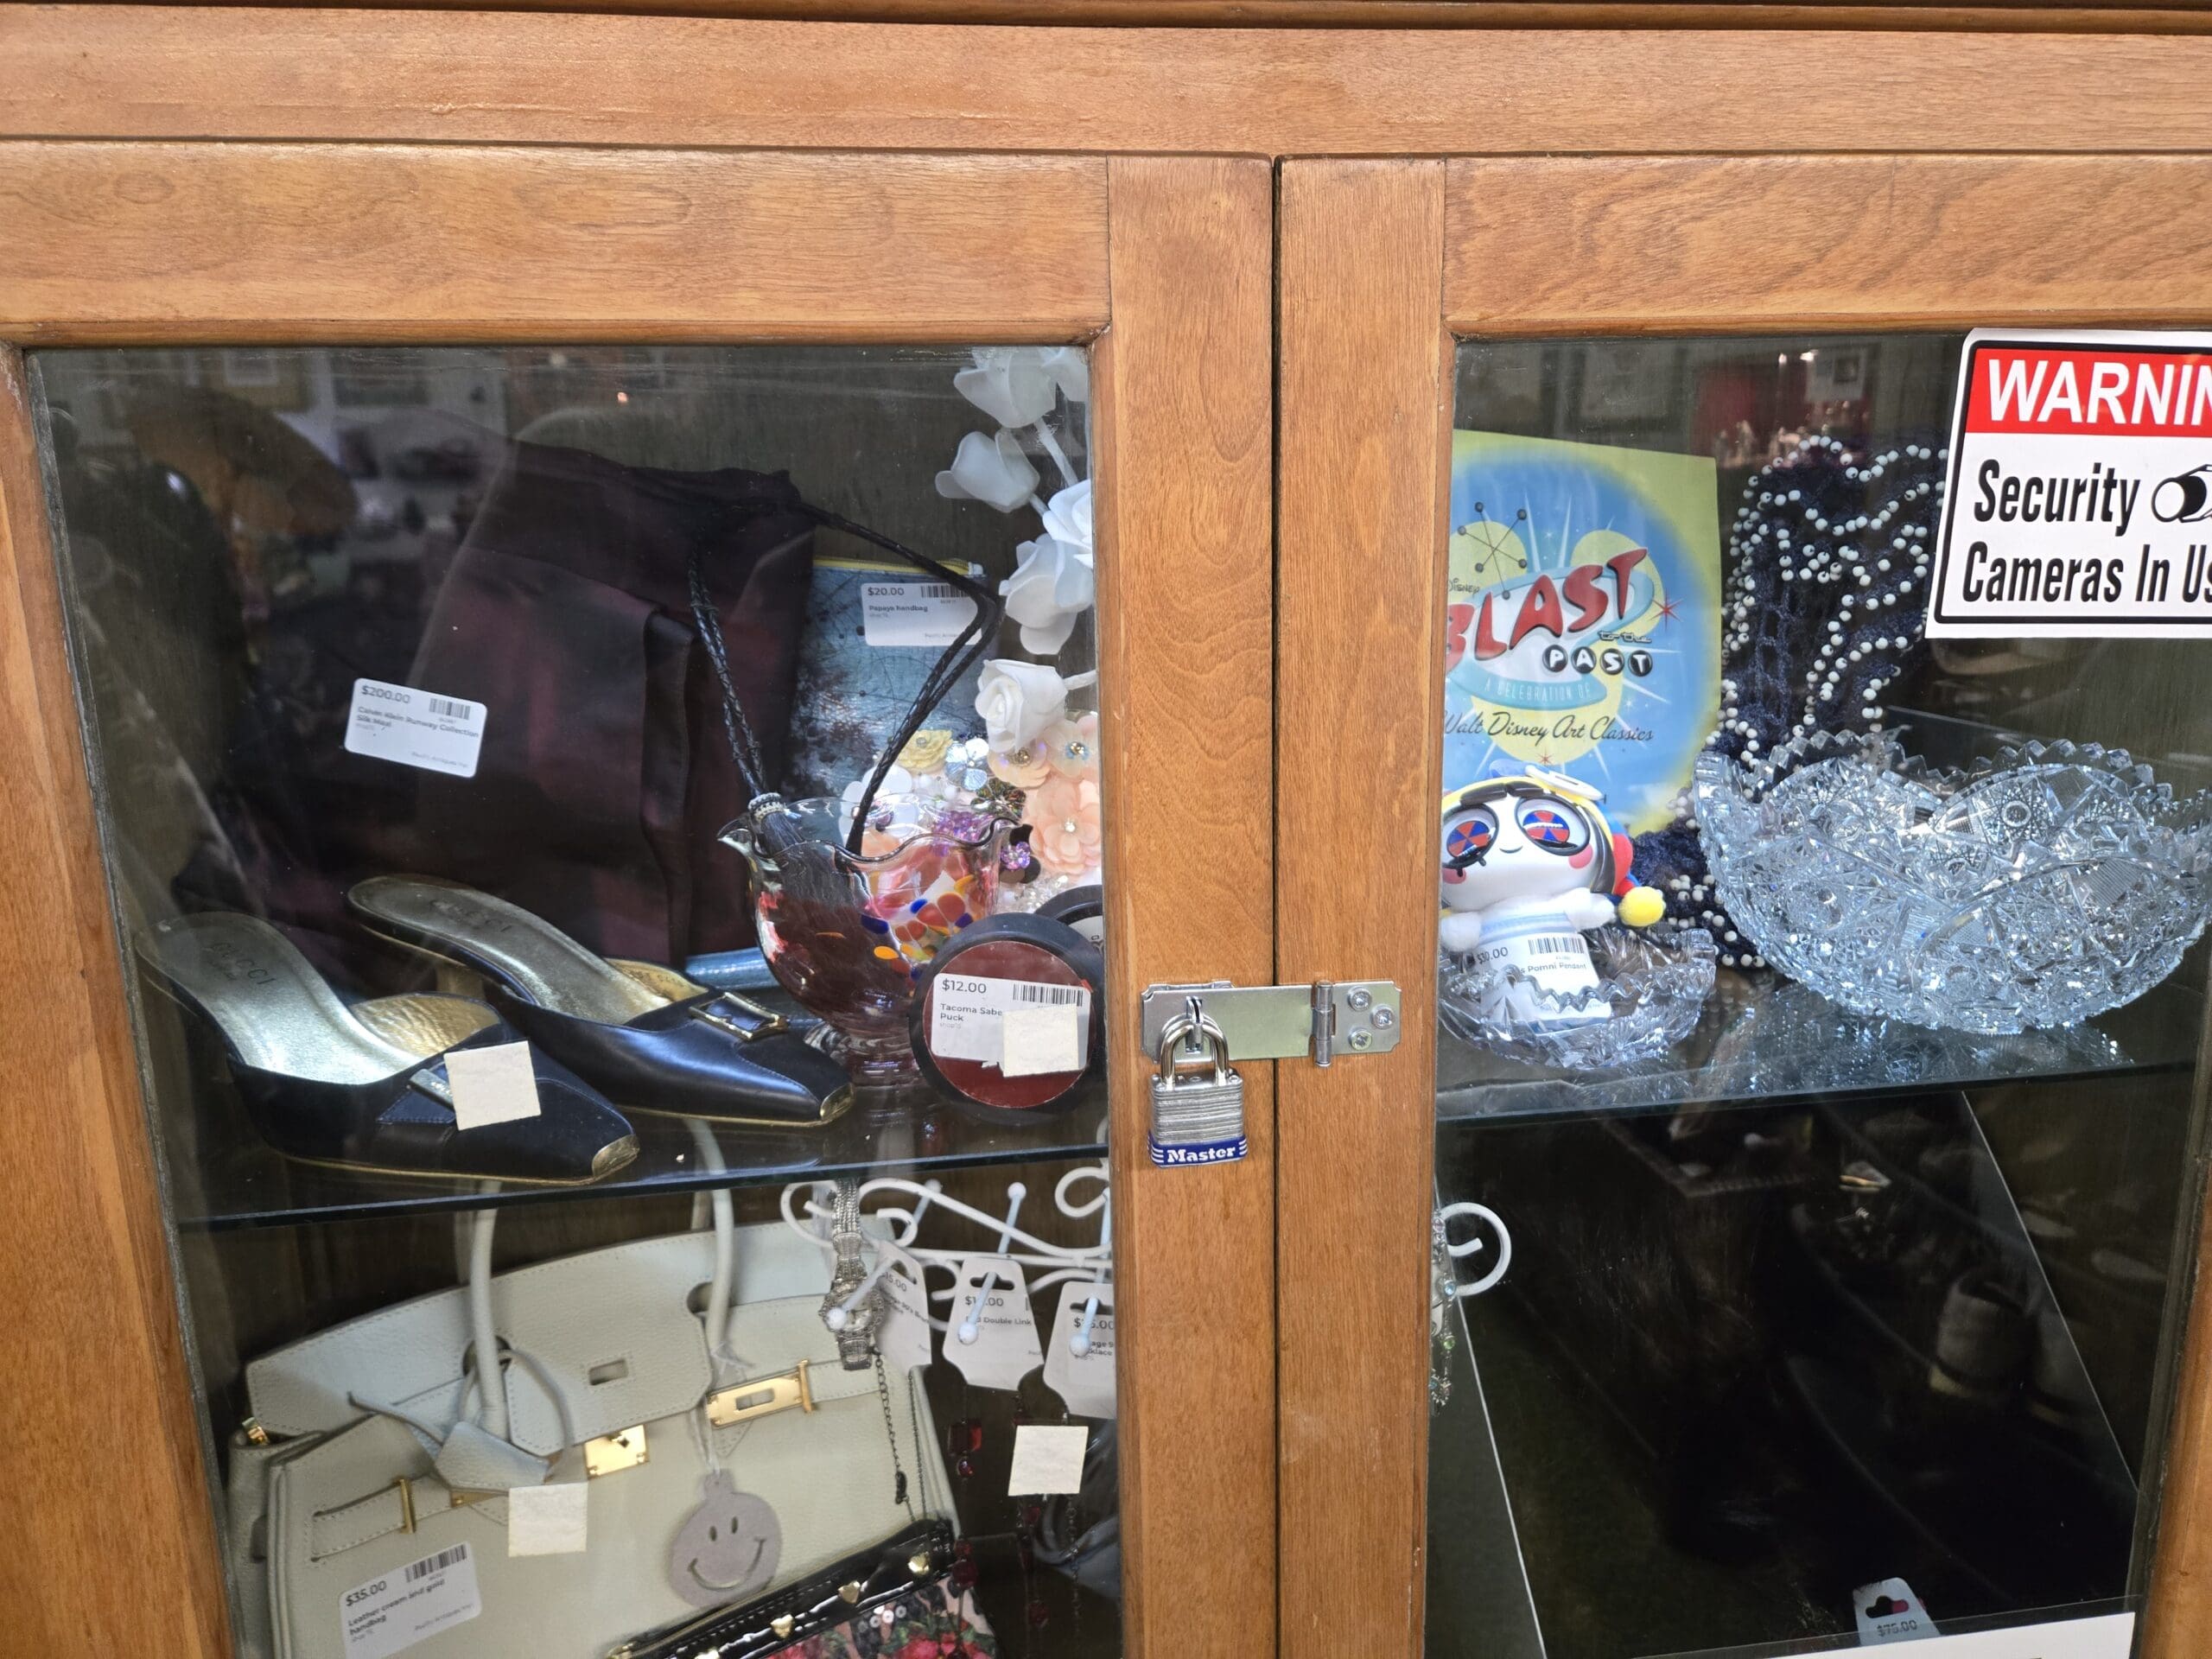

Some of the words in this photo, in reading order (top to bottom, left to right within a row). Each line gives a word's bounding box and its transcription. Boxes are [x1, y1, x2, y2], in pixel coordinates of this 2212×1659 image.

[1974, 459, 2141, 537] Security
[1962, 541, 2124, 602] Cameras
[2135, 543, 2171, 602] In
[868, 586, 905, 597] $20.00
[1446, 549, 1648, 675] BLAST
[1547, 647, 1649, 675] PAST
[361, 684, 411, 704] $200.00
[1497, 681, 1573, 702] CELEBRATION
[1578, 682, 1591, 701] OF
[1444, 709, 1484, 734] Walt
[1488, 711, 1548, 747] Disney
[1552, 715, 1586, 740] Art
[1589, 715, 1654, 741] Classics
[942, 977, 988, 995] $12.00
[940, 1002, 977, 1014] Tacoma
[940, 1012, 964, 1022] Puck
[1166, 1147, 1236, 1163] Master
[964, 1294, 1004, 1307] $1.00
[983, 1316, 1013, 1325] Double
[345, 1580, 388, 1607] $35.00
[347, 1605, 380, 1627] Leather
[349, 1614, 388, 1636] handbag
